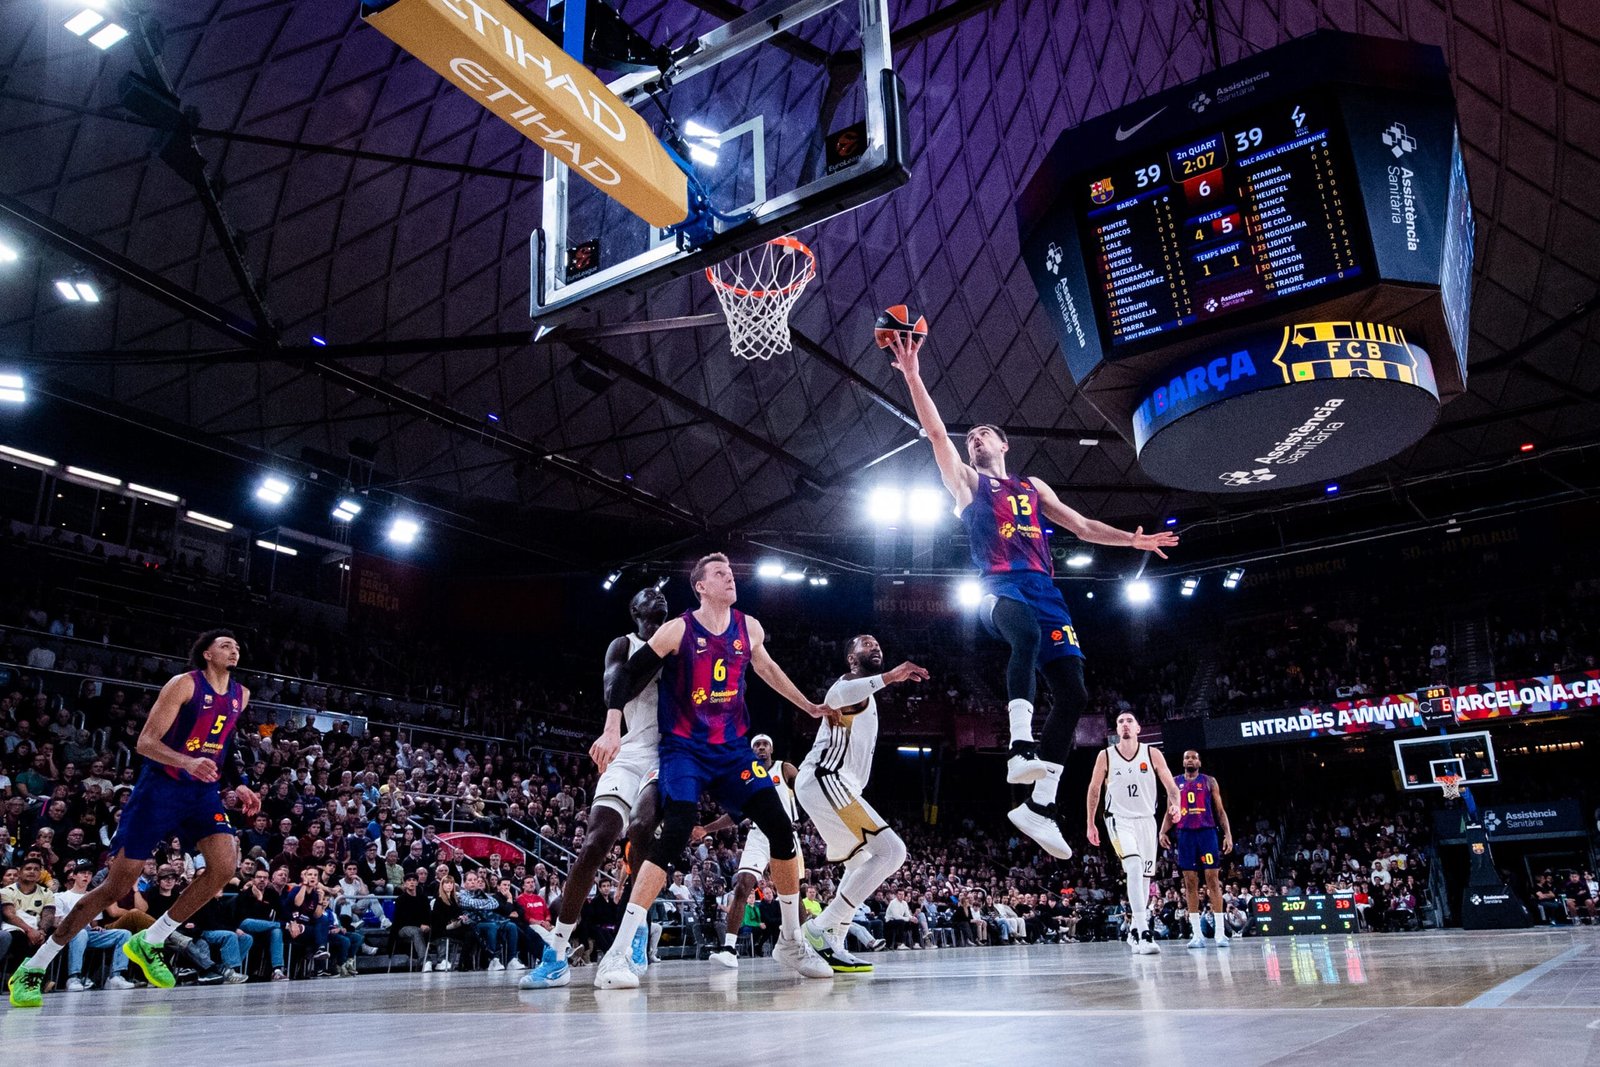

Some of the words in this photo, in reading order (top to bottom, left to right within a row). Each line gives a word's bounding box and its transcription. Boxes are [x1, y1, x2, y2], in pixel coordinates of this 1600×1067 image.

[1216, 71, 1270, 96] Assistència
[449, 57, 621, 185] ETIHAD
[1234, 127, 1263, 152] 39
[1176, 151, 1188, 160] 2n
[1188, 139, 1217, 156] QUART
[1239, 156, 1255, 168] LDLC
[1255, 150, 1276, 162] ASVEL
[1276, 132, 1327, 154] VILLEURBANNE
[1182, 151, 1216, 175] 2:07
[1135, 163, 1161, 188] 39
[1252, 165, 1282, 181] ATAMNA
[1254, 172, 1292, 191] HARRISON
[1198, 180, 1211, 197] 6
[1255, 184, 1288, 200] HEURTEL
[1387, 165, 1405, 224] Sanitària
[1258, 196, 1285, 210] AJINCA
[1400, 166, 1420, 251] Assistència
[1198, 210, 1223, 224] FALTES
[1254, 224, 1262, 232] 12
[1262, 221, 1273, 230] DE
[1273, 215, 1292, 226] COLO
[1334, 199, 1341, 207] 11
[1260, 206, 1286, 220] MASSA
[1102, 219, 1127, 232] PUNTER
[1221, 217, 1233, 234] 5
[1256, 234, 1264, 242] 16
[1264, 220, 1307, 240] NGOUGAMA
[1104, 227, 1131, 242] MARCOS
[1195, 229, 1204, 241] 4
[1105, 240, 1122, 250] CALE
[1257, 243, 1266, 252] 23
[1266, 235, 1292, 249] LIGHTY
[1107, 246, 1132, 260] NORRIS
[1196, 251, 1219, 262] TEMPS
[1220, 243, 1240, 255] MORT
[1231, 255, 1240, 267] 1
[1259, 253, 1268, 261] 24
[1268, 244, 1296, 259] NDIAYE
[1109, 256, 1133, 269] VESELY
[1203, 264, 1211, 276] 1
[1261, 263, 1271, 271] 30
[1270, 253, 1302, 268] WATSON
[1106, 282, 1113, 290] 13
[1113, 269, 1155, 288] SATORANSKY
[1111, 263, 1144, 279] BRIZUELA
[1263, 273, 1273, 281] 32
[1272, 263, 1305, 278] VAUTIER
[1115, 275, 1165, 297] HERNANGÓMEZ
[1275, 273, 1304, 288] TRAORE
[1277, 284, 1302, 296] PIERRIC
[1302, 276, 1327, 289] POUPET
[1338, 271, 1344, 279] 0
[1109, 300, 1117, 308] 19
[1116, 296, 1133, 306] FALL
[1220, 288, 1254, 302] Assistència
[1054, 283, 1073, 334] Sanitària
[1060, 277, 1086, 348] Assistència
[1118, 300, 1148, 315] CLYBURN
[1112, 319, 1120, 327] 23
[1120, 308, 1157, 324] SHENGELIA
[1122, 322, 1145, 333] PARRA
[1124, 332, 1138, 341] XAVI
[1138, 325, 1162, 337] PASCUAL
[1153, 350, 1257, 417] BARÇA
[1254, 398, 1345, 464] Assistència
[1276, 422, 1345, 464] Sanitària
[1006, 494, 1032, 515] 13
[713, 658, 726, 682] 6
[1441, 698, 1451, 711] 6
[210, 714, 227, 734] 5
[1240, 711, 1335, 737] ENTRADES
[1338, 709, 1352, 726] A
[751, 760, 768, 778] 6
[1127, 783, 1139, 798] 12
[1187, 791, 1195, 804] 0
[1505, 808, 1557, 820] Assistència
[1506, 818, 1544, 829] Sanitària
[1205, 852, 1214, 865] 0
[1257, 903, 1271, 912] 39
[1282, 901, 1306, 911] 2:07
[1316, 901, 1323, 910] 2
[1336, 899, 1350, 909] 39
[1262, 924, 1269, 932] 4
[1344, 921, 1351, 929] 5
